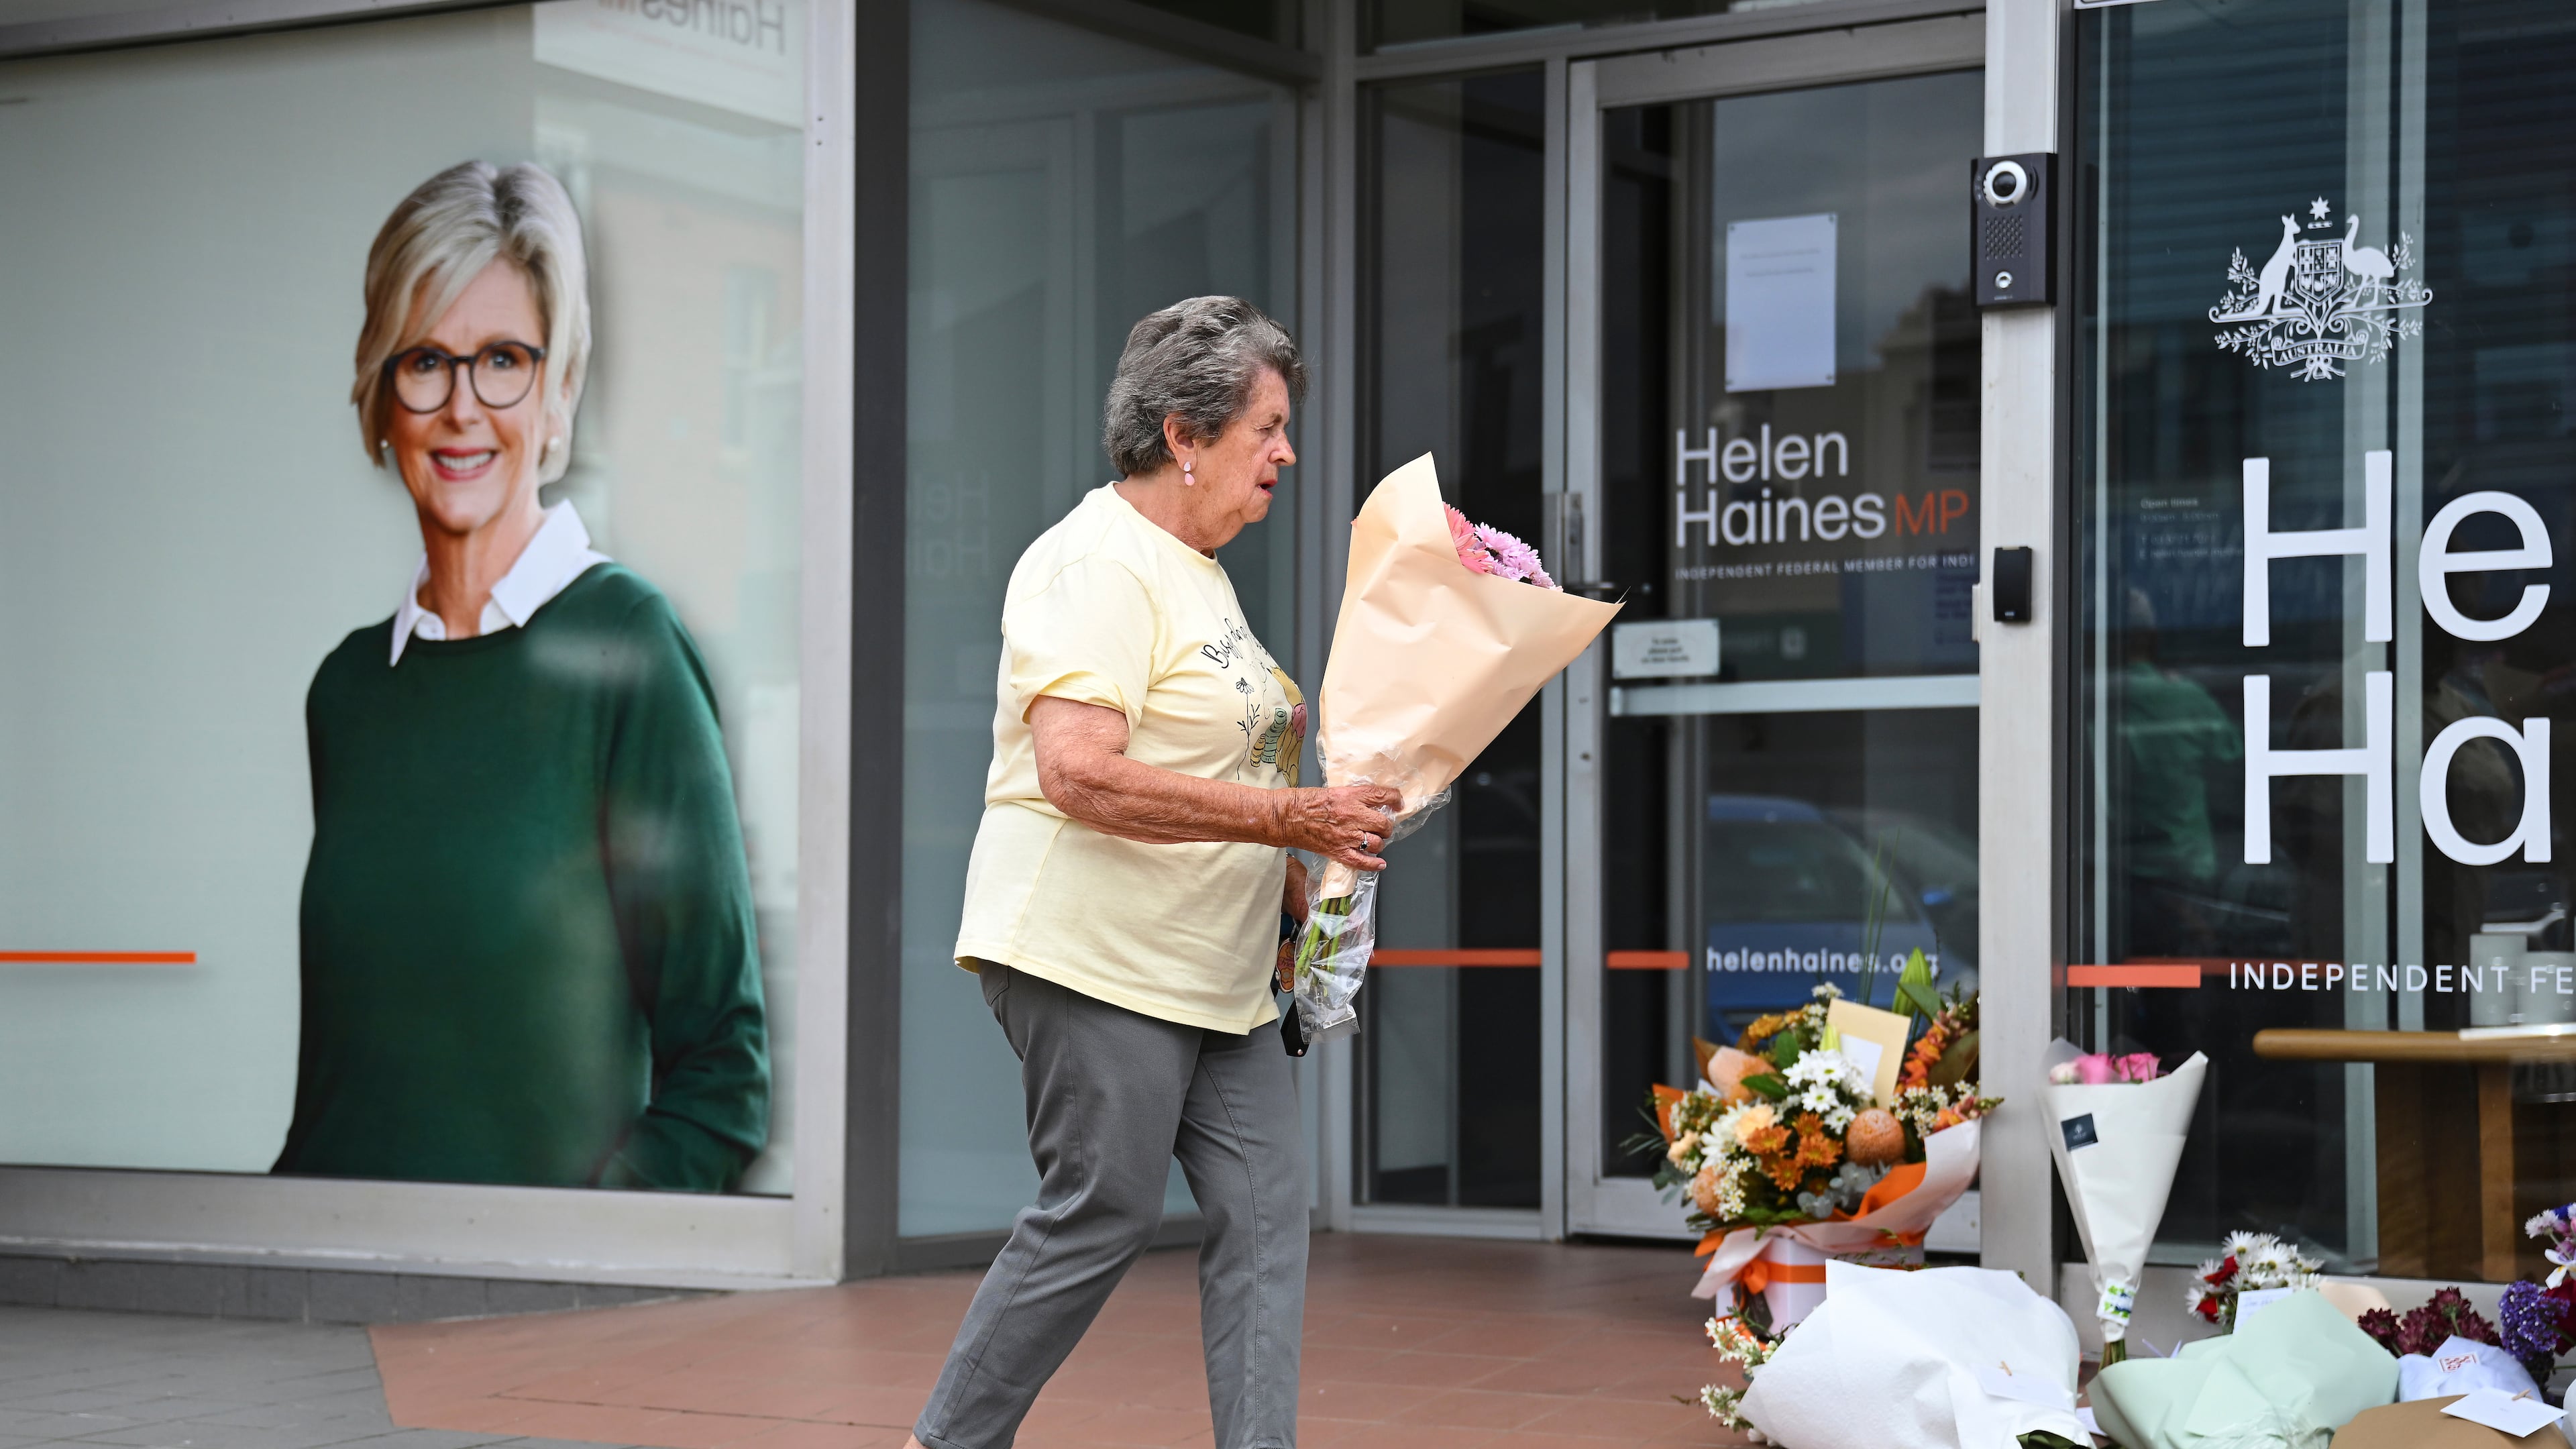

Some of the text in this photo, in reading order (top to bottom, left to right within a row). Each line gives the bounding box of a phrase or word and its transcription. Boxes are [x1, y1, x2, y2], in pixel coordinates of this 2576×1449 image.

[2279, 342, 2357, 363] AUSTRALIA
[1676, 423, 1849, 487] Helen
[1676, 488, 1970, 548] Haines MP
[1675, 553, 1975, 581] INDEPENDENT FEDERAL MEMBER FOR INDI
[2243, 449, 2553, 647] He
[2243, 671, 2553, 866] Ha
[1706, 947, 1940, 979] helenhaines.og
[2229, 962, 2574, 995] INDEPENDENT FE
